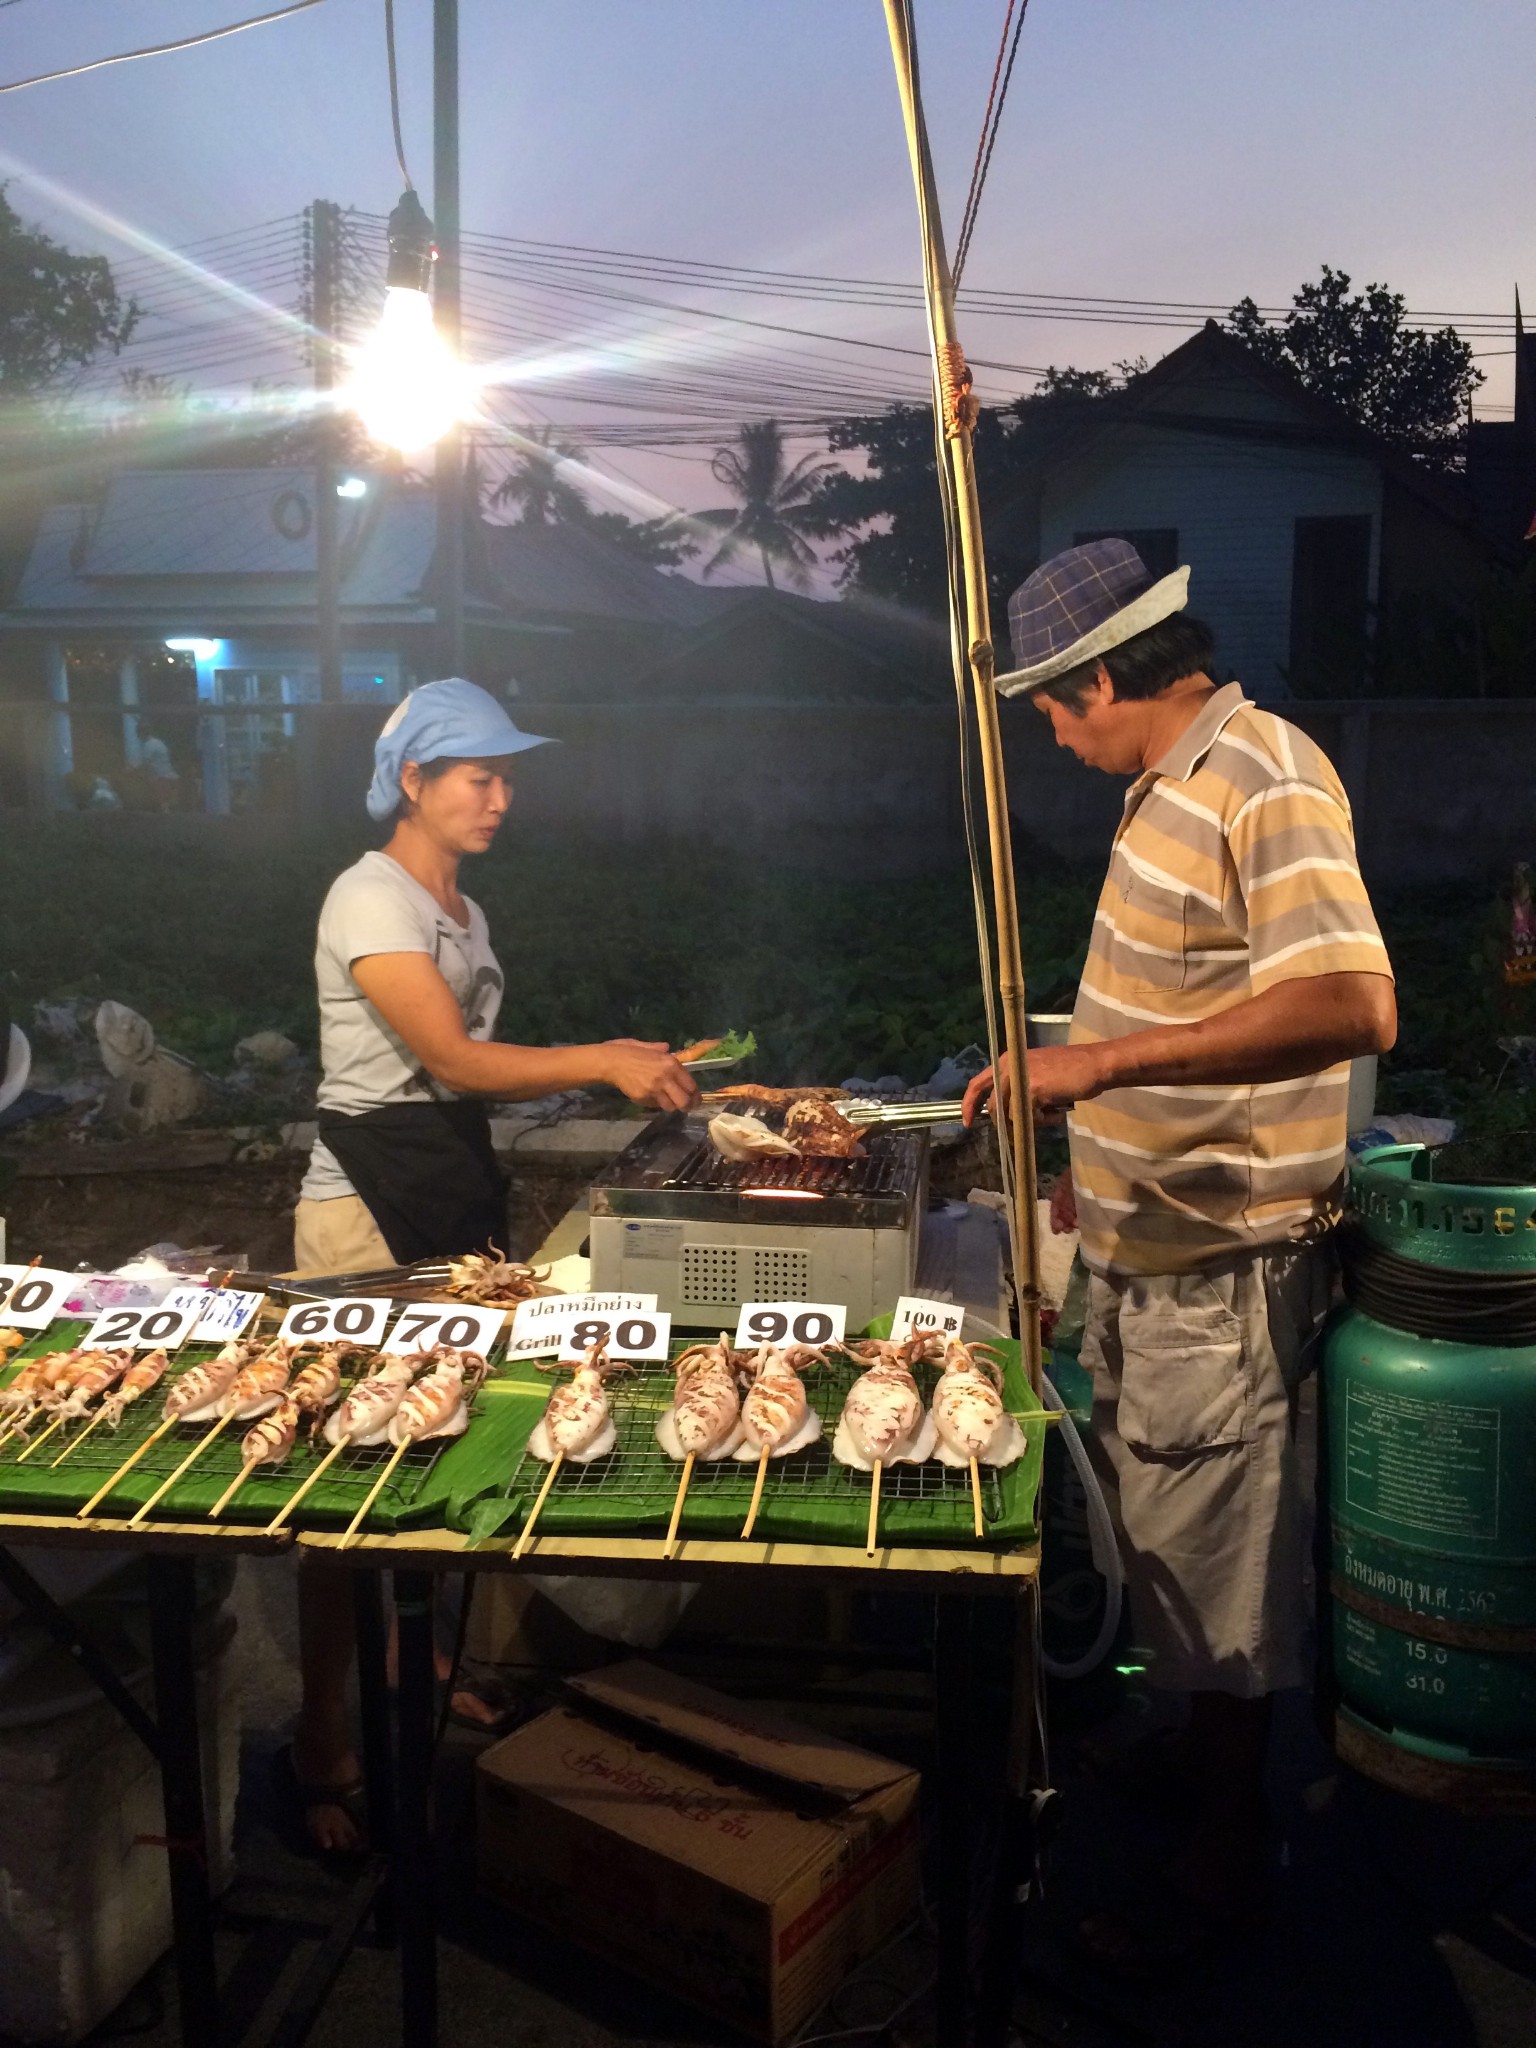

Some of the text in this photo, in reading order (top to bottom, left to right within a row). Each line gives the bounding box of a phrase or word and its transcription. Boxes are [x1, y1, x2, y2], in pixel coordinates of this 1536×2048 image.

[289, 1303, 375, 1335] 60
[529, 1295, 642, 1317] ปลาหมึกย่าง
[903, 1311, 936, 1327] 100
[92, 1311, 183, 1342] 20
[398, 1314, 480, 1347] 70
[570, 1319, 657, 1350] 80
[747, 1311, 833, 1344] 90
[516, 1334, 562, 1351] Grill
[1419, 1581, 1451, 1609] พ.ศ.
[1406, 1640, 1447, 1665] 15.0
